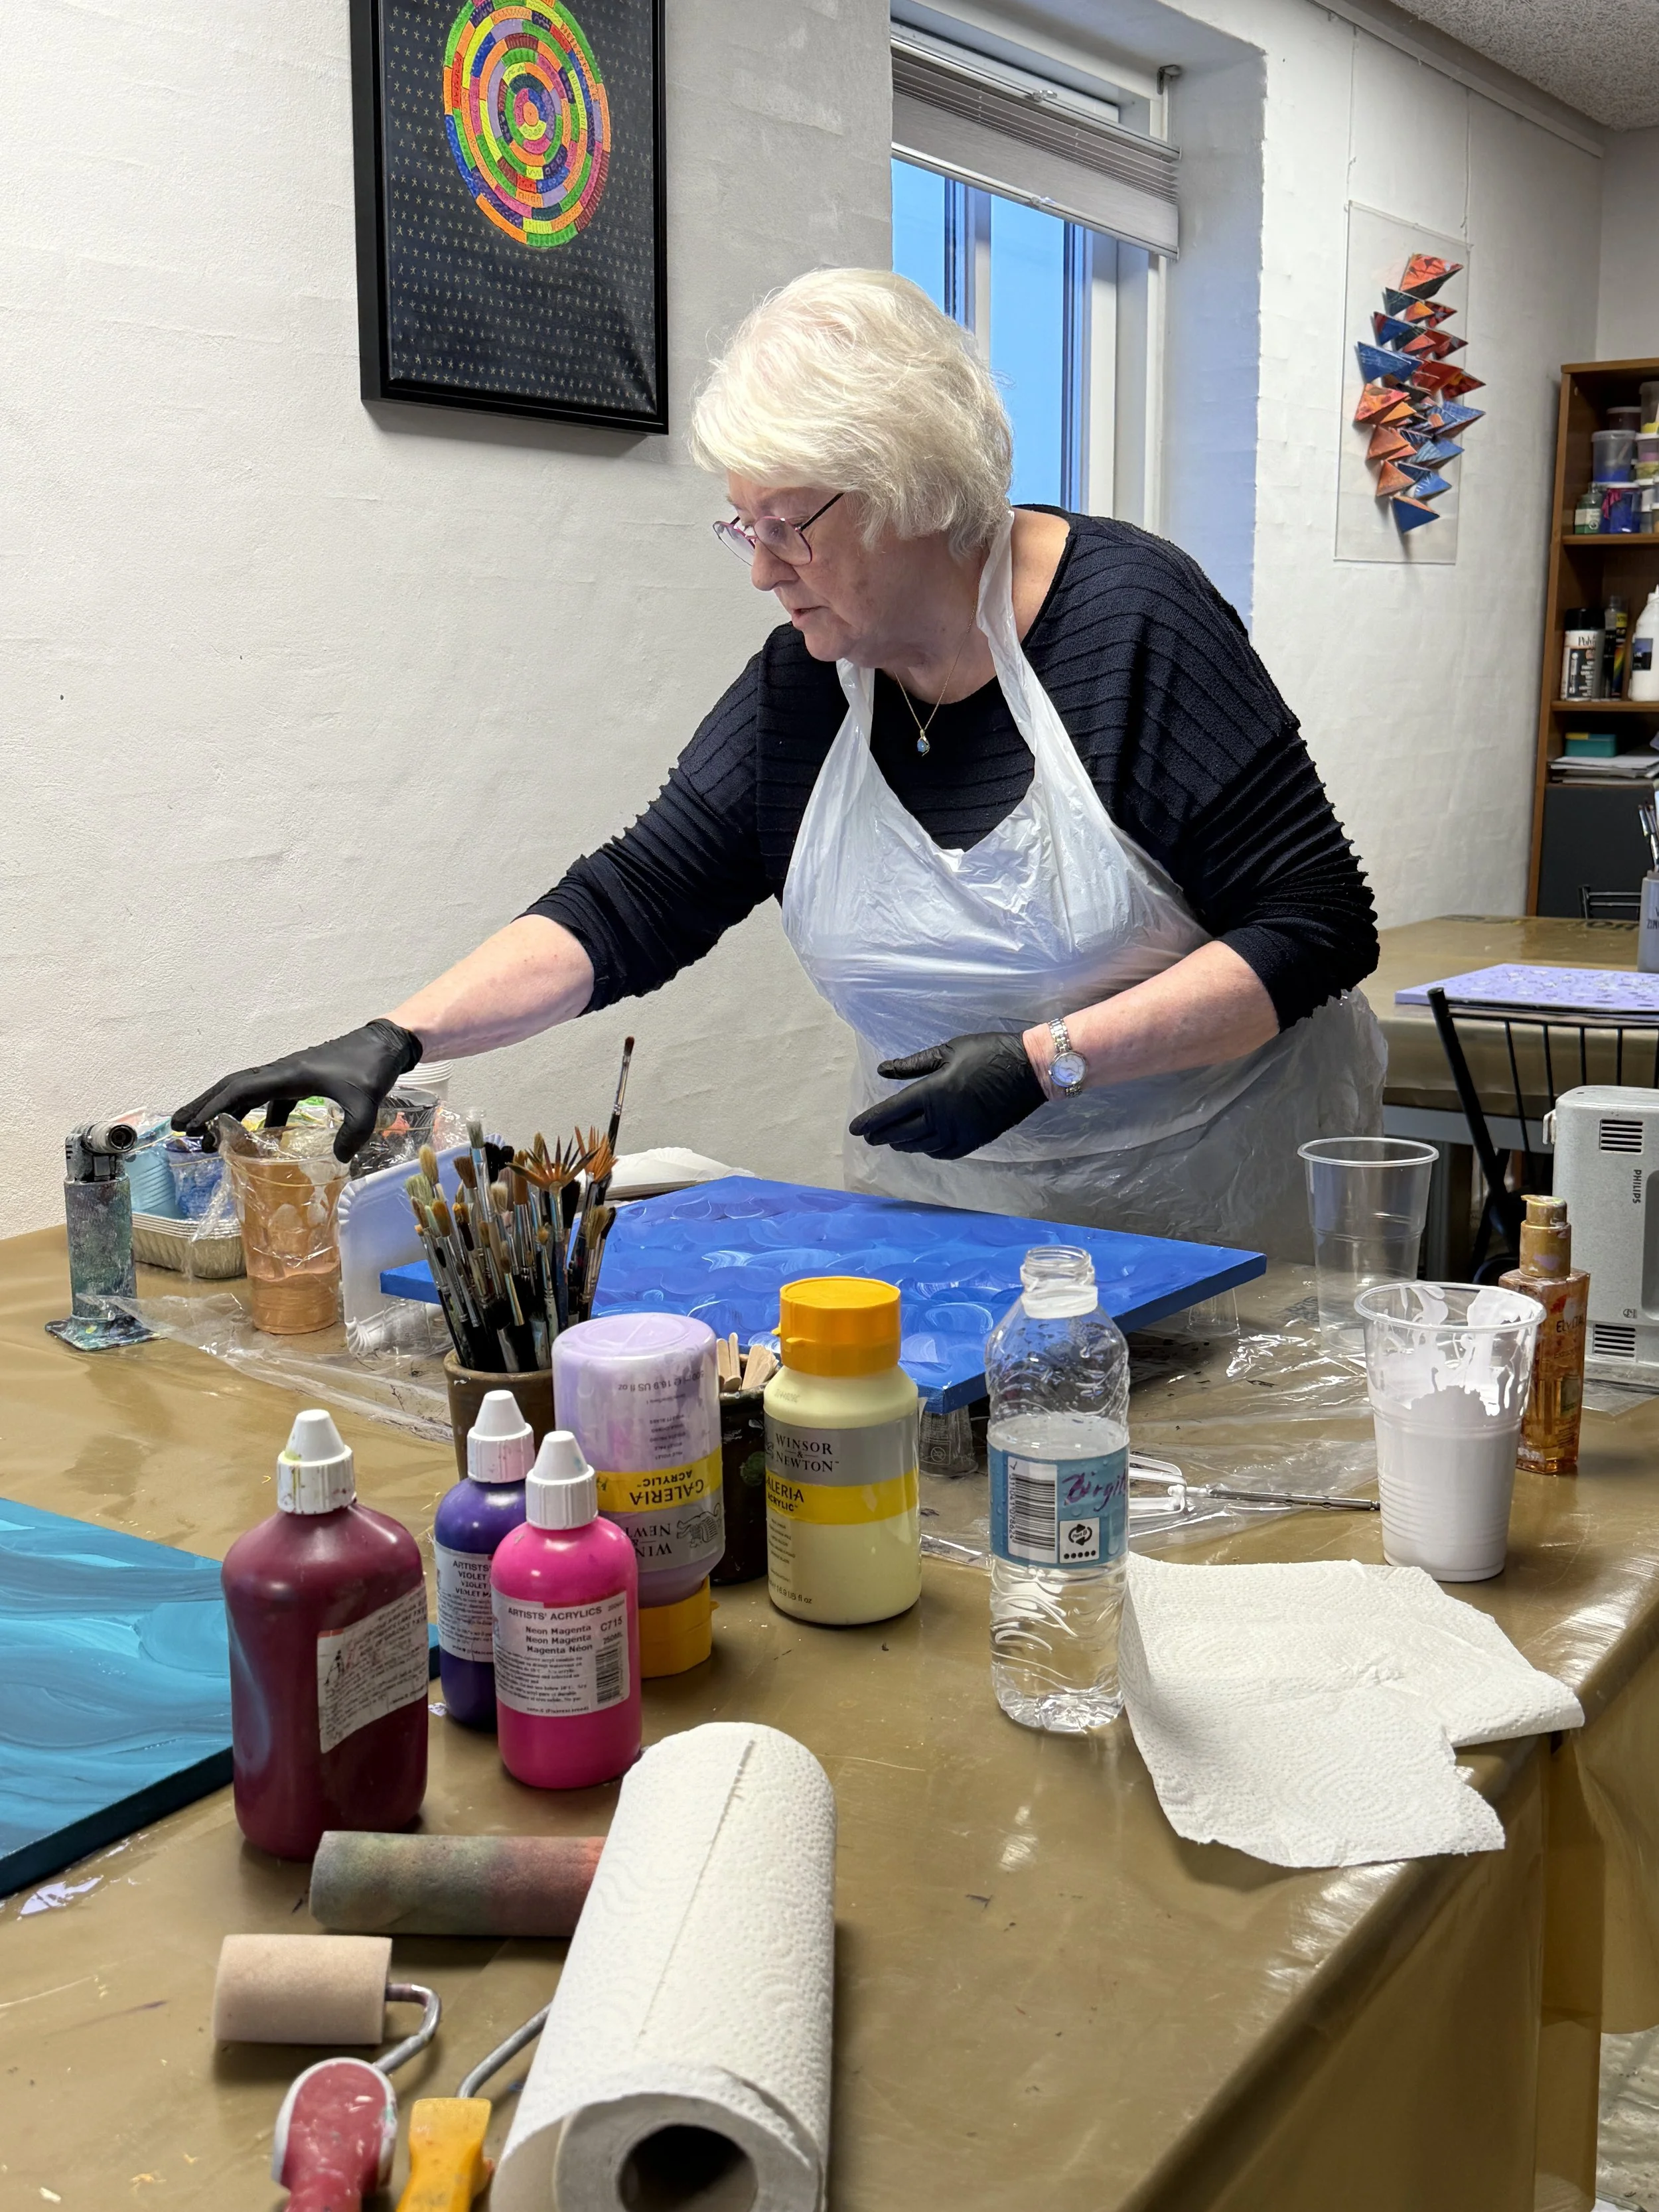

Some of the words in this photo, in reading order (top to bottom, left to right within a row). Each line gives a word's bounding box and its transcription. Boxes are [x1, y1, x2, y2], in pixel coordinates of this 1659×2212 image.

[1632, 1169, 1642, 1204] PHILIPS
[638, 1382, 651, 1392] US
[775, 1433, 833, 1455] WINSOR
[776, 1450, 834, 1473] NEWTON
[642, 1469, 693, 1487] ACRYLIC
[629, 1479, 704, 1506] GALERIA
[766, 1475, 804, 1503] ALERIA
[625, 1523, 671, 1538] NEWT
[635, 1542, 672, 1558] WIN
[458, 1570, 487, 1580] VIOLET
[455, 1587, 480, 1597] VIOLET
[461, 1580, 487, 1589] VIOLET
[508, 1607, 547, 1620] ARTISTS'
[550, 1606, 603, 1621] ACRYLICS
[526, 1626, 548, 1635] Neon
[551, 1625, 592, 1635] Magenta
[600, 1616, 622, 1632] C715
[526, 1635, 549, 1644] Neon
[551, 1634, 592, 1645] Magenta
[526, 1645, 565, 1655] Magenta
